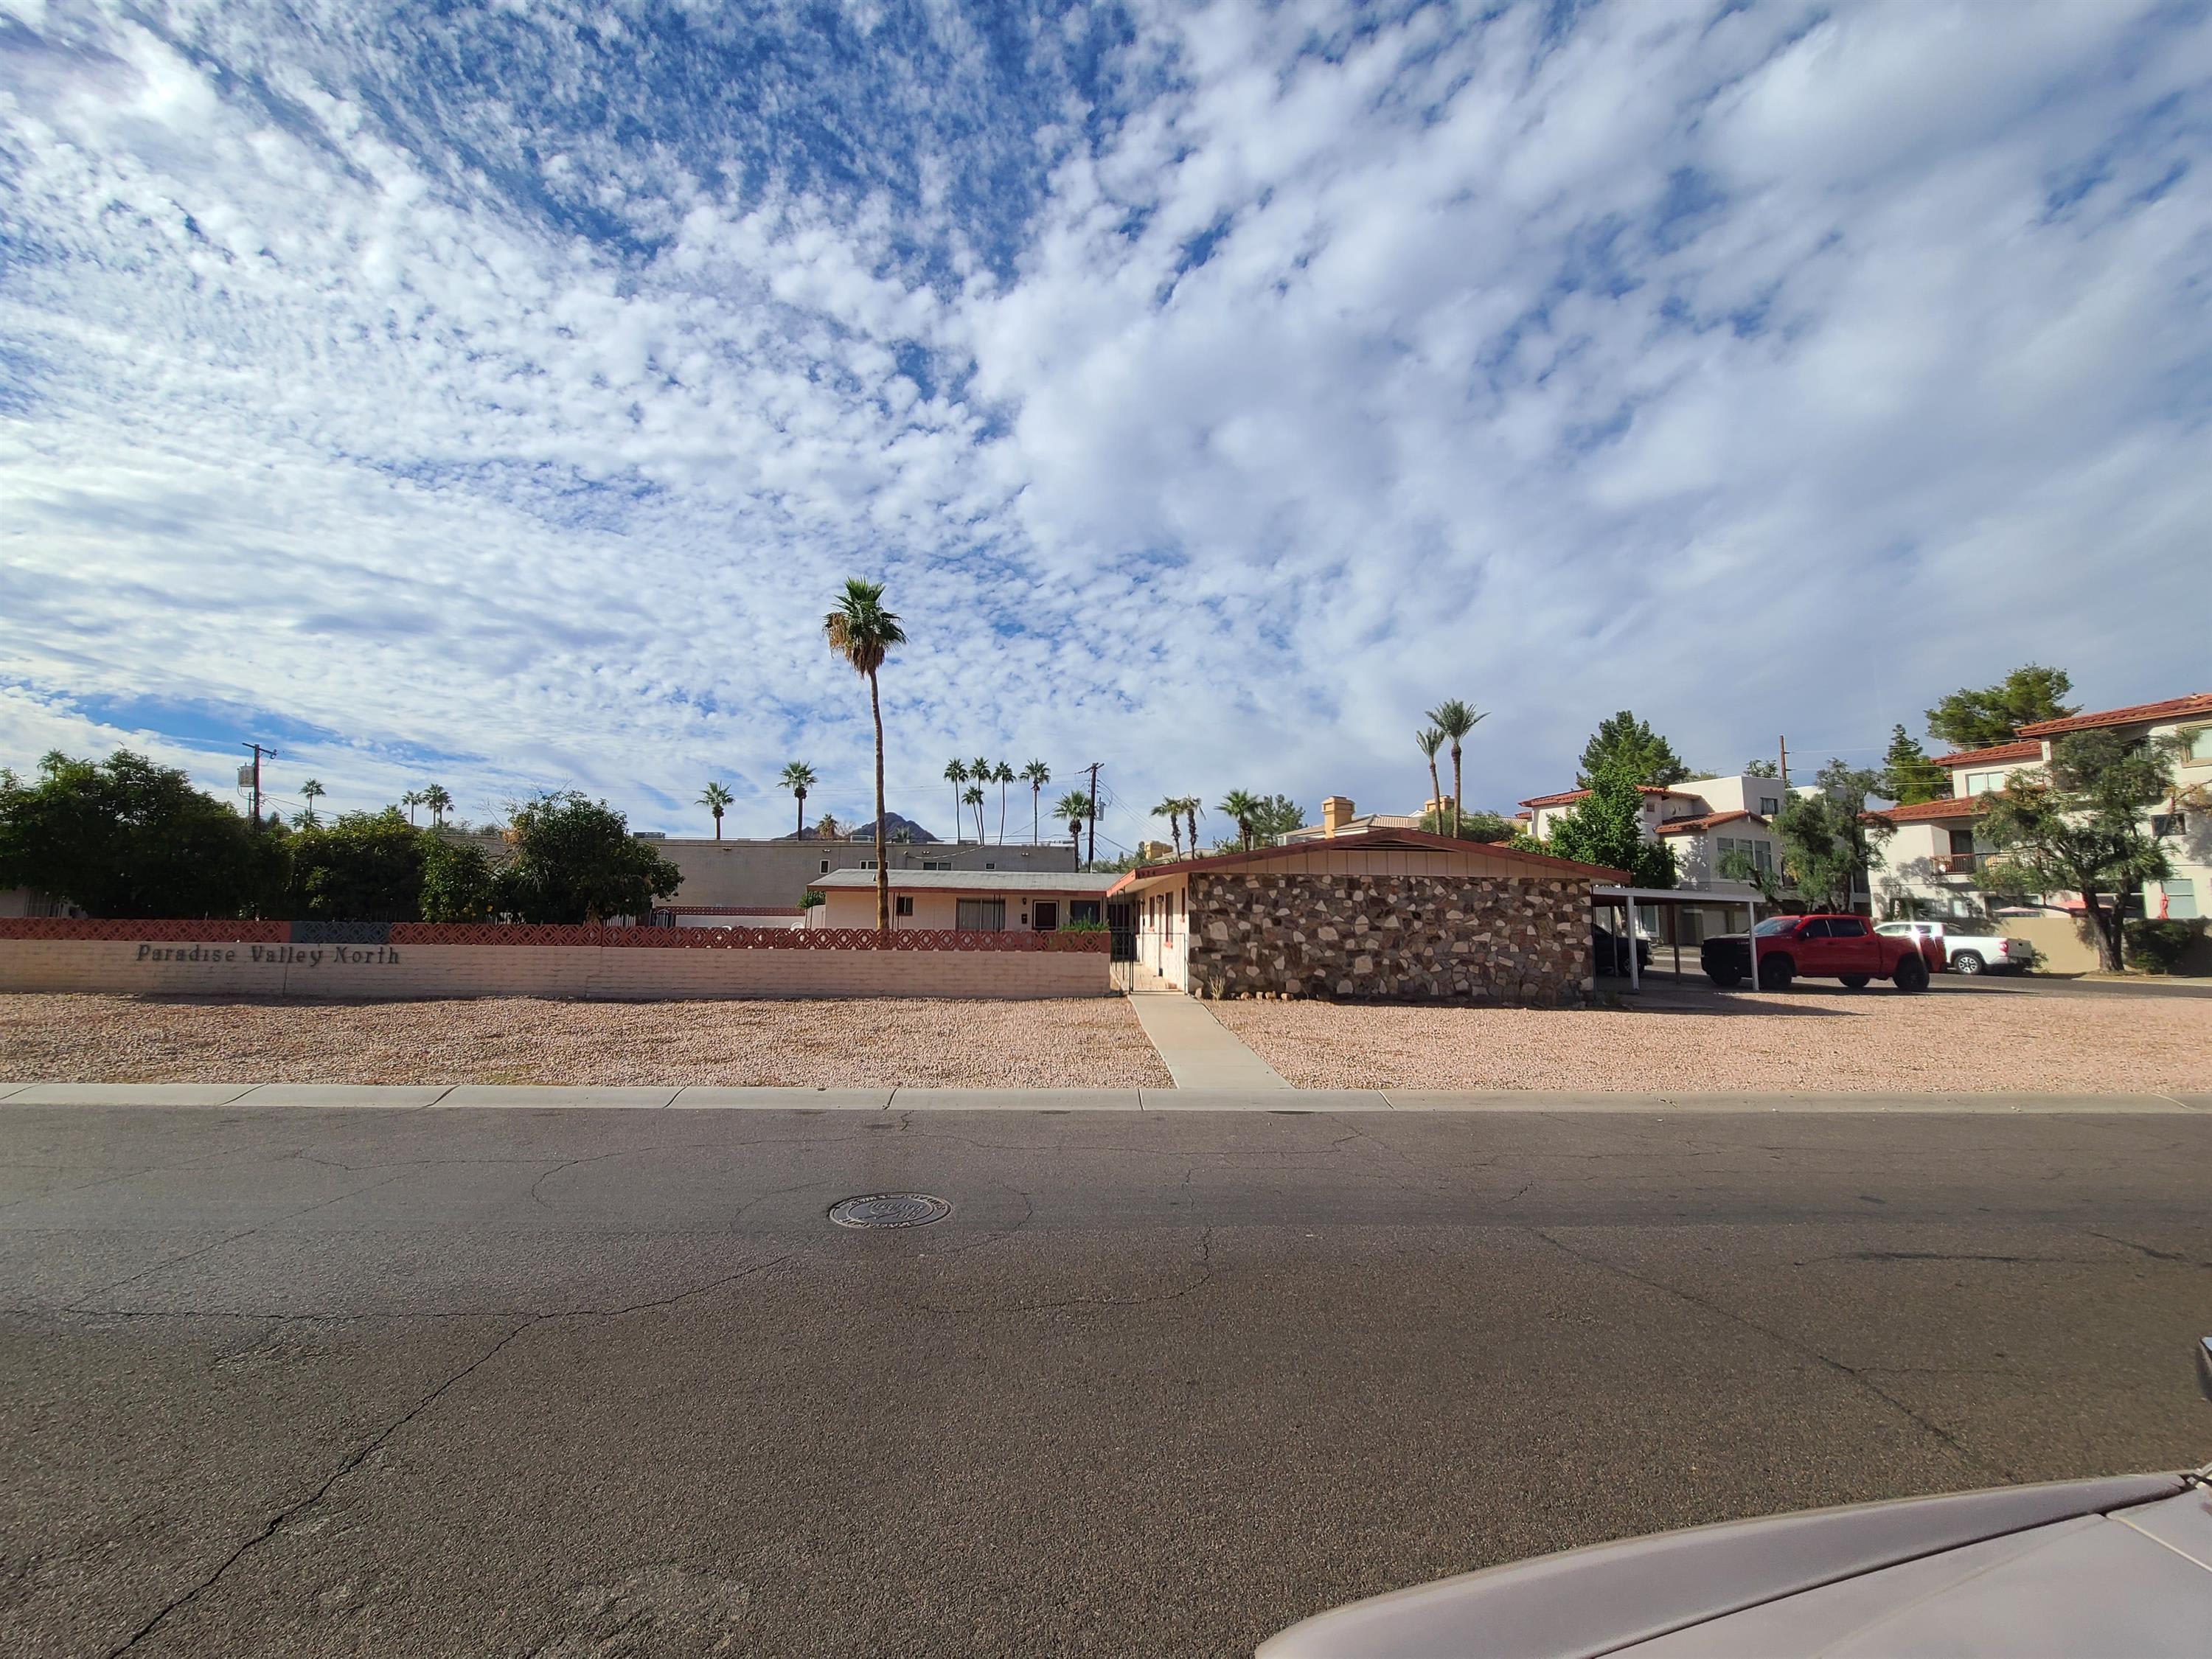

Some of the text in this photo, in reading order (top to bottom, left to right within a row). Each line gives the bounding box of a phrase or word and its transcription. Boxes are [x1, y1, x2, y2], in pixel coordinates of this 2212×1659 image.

[136, 945, 400, 967] Paradise Valley North
